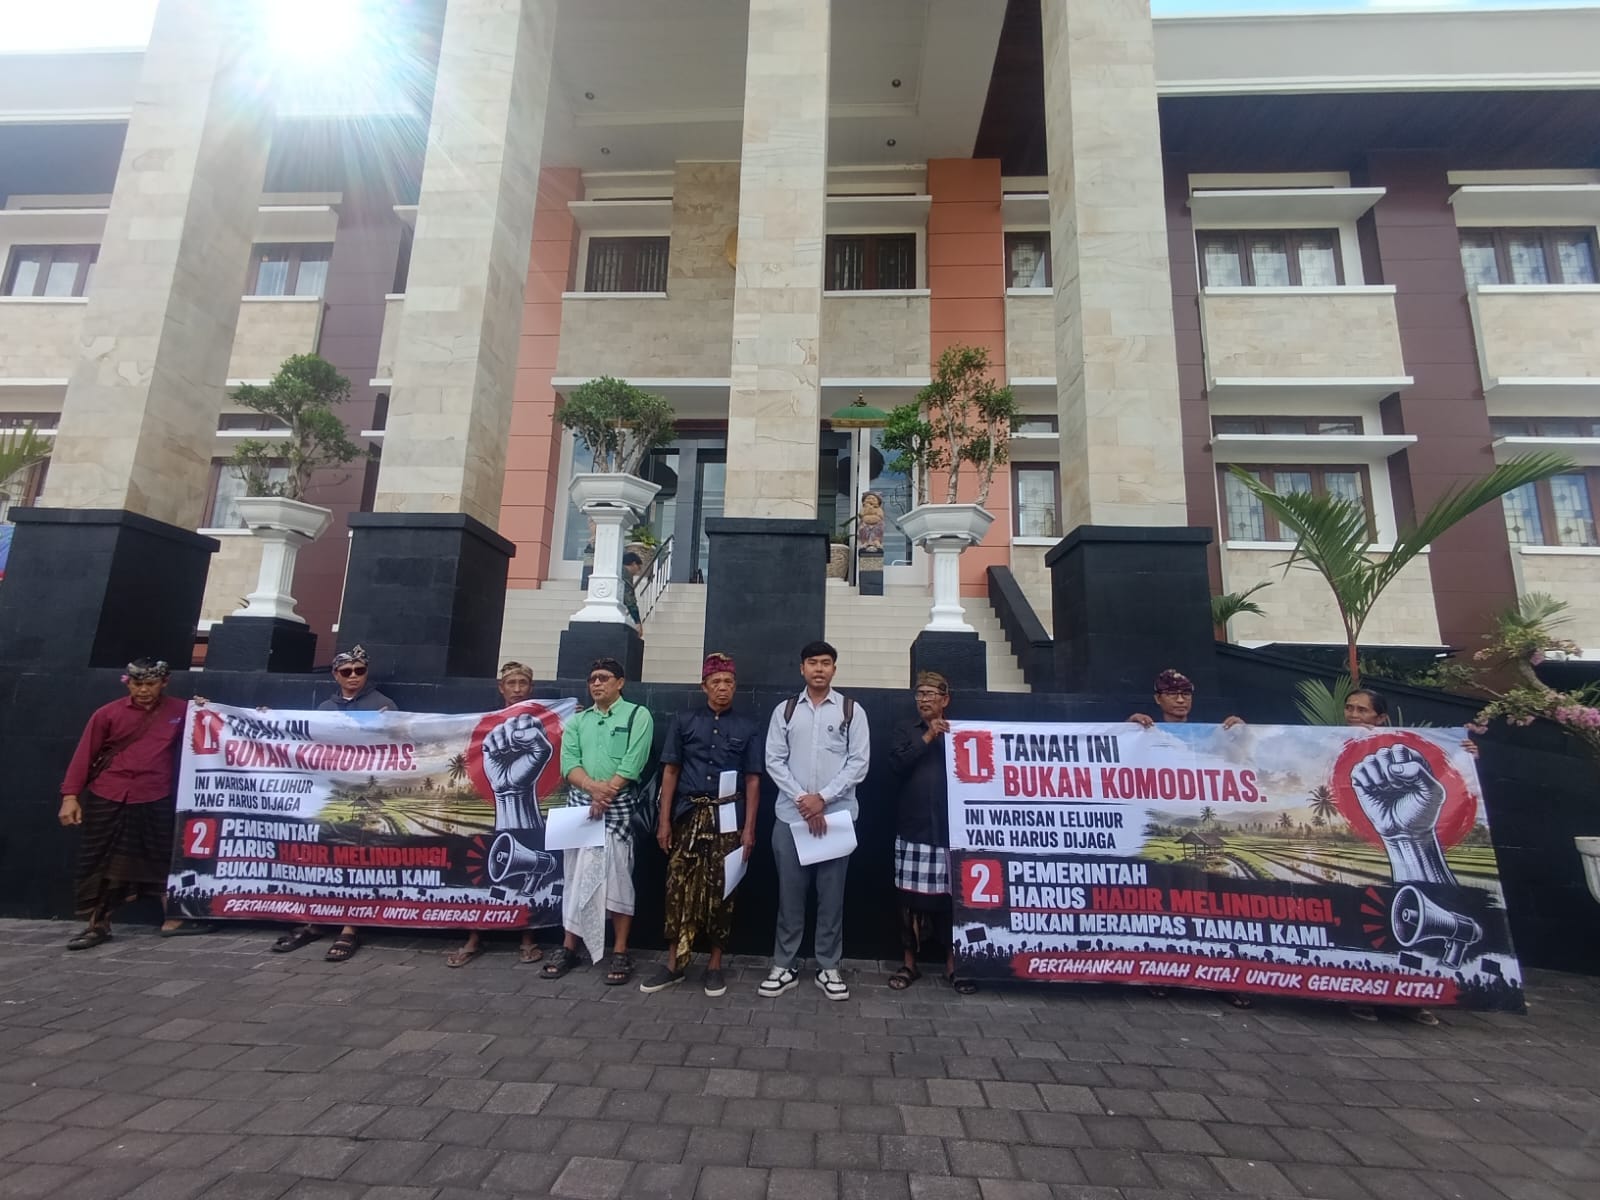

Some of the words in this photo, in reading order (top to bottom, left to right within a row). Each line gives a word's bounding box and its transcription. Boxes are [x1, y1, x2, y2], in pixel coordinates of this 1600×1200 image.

[202, 715, 217, 749] 1.
[286, 720, 313, 741] INI
[295, 743, 417, 772] KOMODITAS.
[964, 737, 988, 777] 1.
[1000, 734, 1079, 763] TANAH
[1087, 735, 1120, 763] INI
[194, 776, 209, 790] INI
[214, 777, 257, 793] WARISAN
[259, 778, 314, 794] LELUHUR
[1003, 765, 1092, 798] BUKAN
[1101, 767, 1267, 802] KOMODITAS.
[194, 793, 224, 807] YANG
[228, 795, 258, 809] HARUS
[261, 797, 300, 811] DIJAGA
[221, 819, 320, 842] PEMERINTAH
[965, 809, 984, 825] INI
[989, 810, 1055, 827] WARISAN
[1060, 811, 1123, 829] LELUHUR
[191, 822, 210, 854] 2.
[966, 829, 1005, 846] YANG
[1010, 830, 1058, 848] HARUS
[1064, 831, 1116, 849] DIJAGA
[218, 840, 276, 859] HARUS
[279, 843, 330, 863] HADIR
[333, 846, 452, 869] MELINDUNGI,
[216, 861, 268, 878] BUKAN
[271, 864, 343, 884] MERAMPAS
[347, 869, 397, 885] TANAH
[402, 869, 446, 886] KAMI.
[970, 864, 999, 903] 2.
[1008, 861, 1147, 885] PEMERINTAH
[224, 899, 306, 914] PERTAHANKAN
[309, 902, 345, 916] TANAH
[349, 903, 377, 918] KITA!
[383, 906, 419, 920] UNTUK
[422, 908, 481, 921] GENERASI
[483, 909, 519, 923] KITA!
[1009, 886, 1085, 909] HARUS
[1092, 887, 1162, 913] HADIR
[1171, 889, 1341, 926] MELINDUNGI,
[1010, 912, 1076, 933] BUKAN
[1080, 913, 1186, 937] MERAMPAS
[1191, 918, 1263, 942] TANAH
[1271, 924, 1335, 947] KAMI.
[1028, 957, 1133, 975] PERTAHANKAN
[1139, 960, 1190, 978] TANAH
[1195, 964, 1240, 982] KITA!
[1246, 969, 1301, 989] UNTUK
[1307, 975, 1388, 995] GENERASI
[1395, 980, 1444, 999] KITA!
